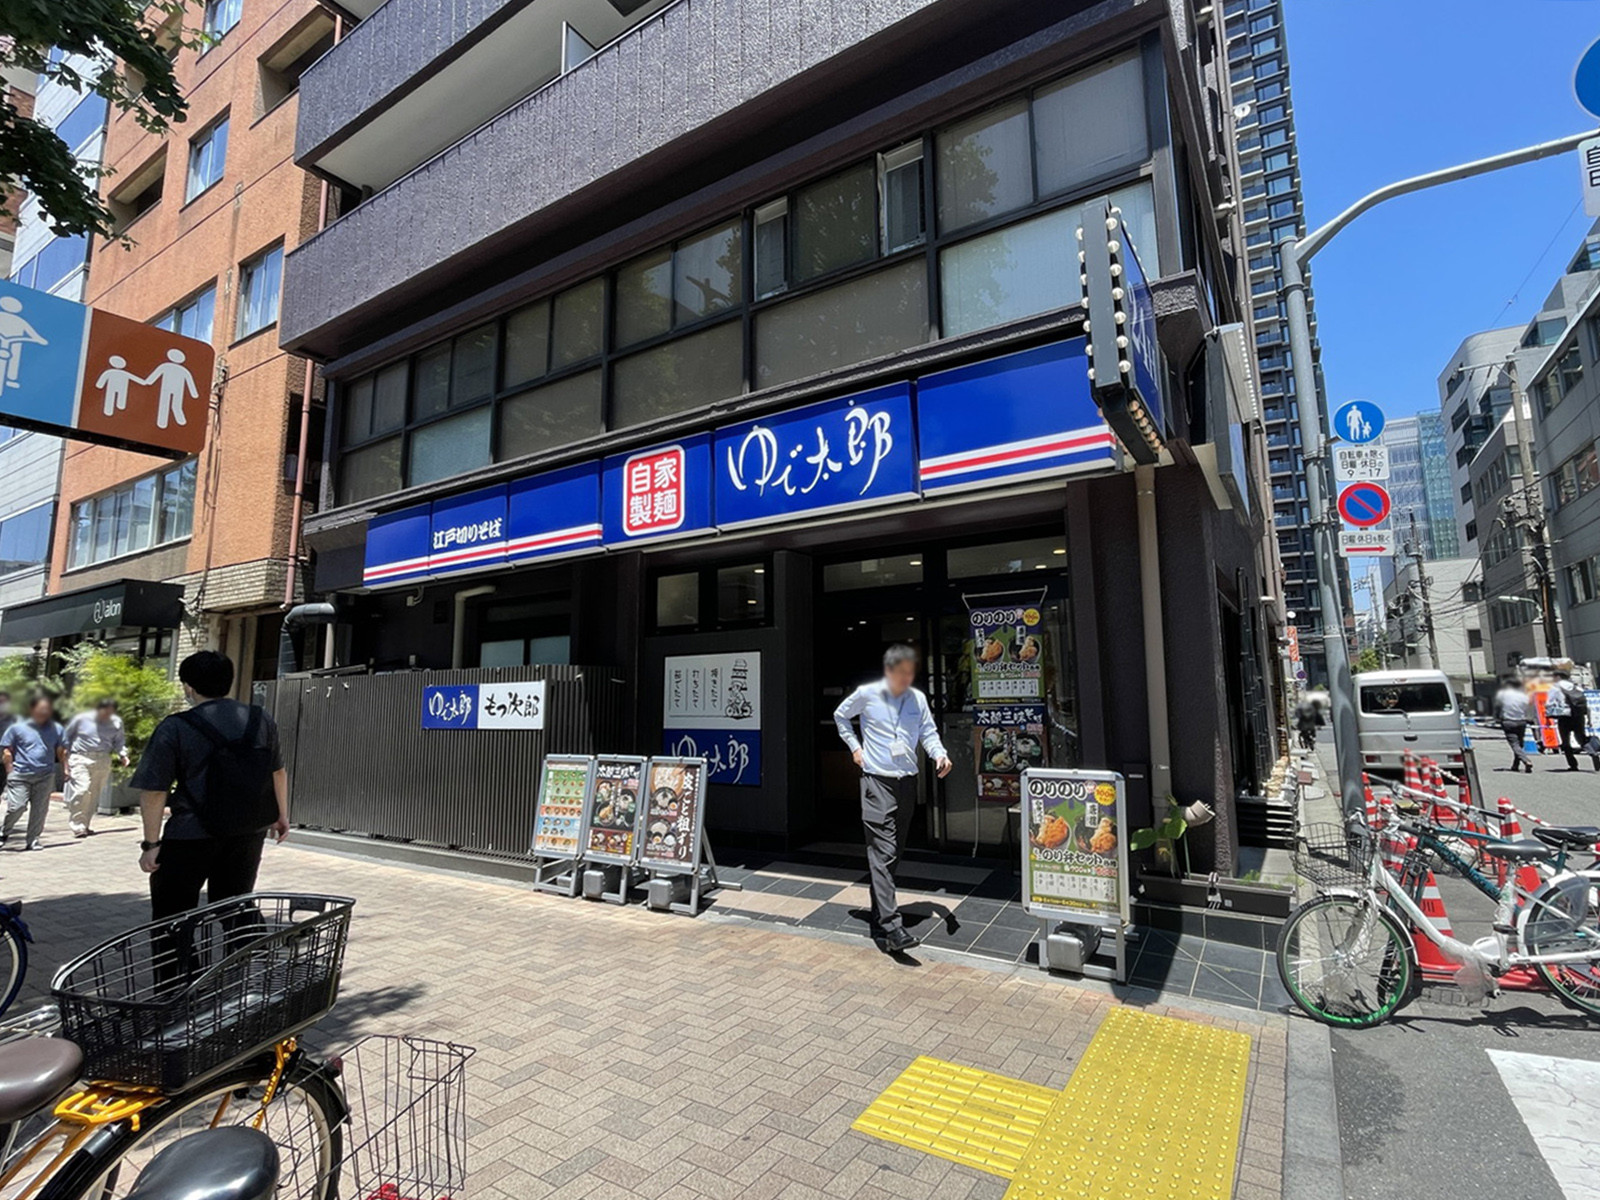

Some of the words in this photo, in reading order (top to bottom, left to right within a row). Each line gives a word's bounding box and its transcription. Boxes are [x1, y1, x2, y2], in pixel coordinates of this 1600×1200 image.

[728, 400, 893, 497] ゆで太郎
[433, 517, 502, 549] 江戸切りそば
[971, 610, 1017, 626] のりのり
[428, 690, 473, 725] ゆで太郎
[484, 691, 541, 719] もつ次郎
[1029, 780, 1087, 800] のりのり
